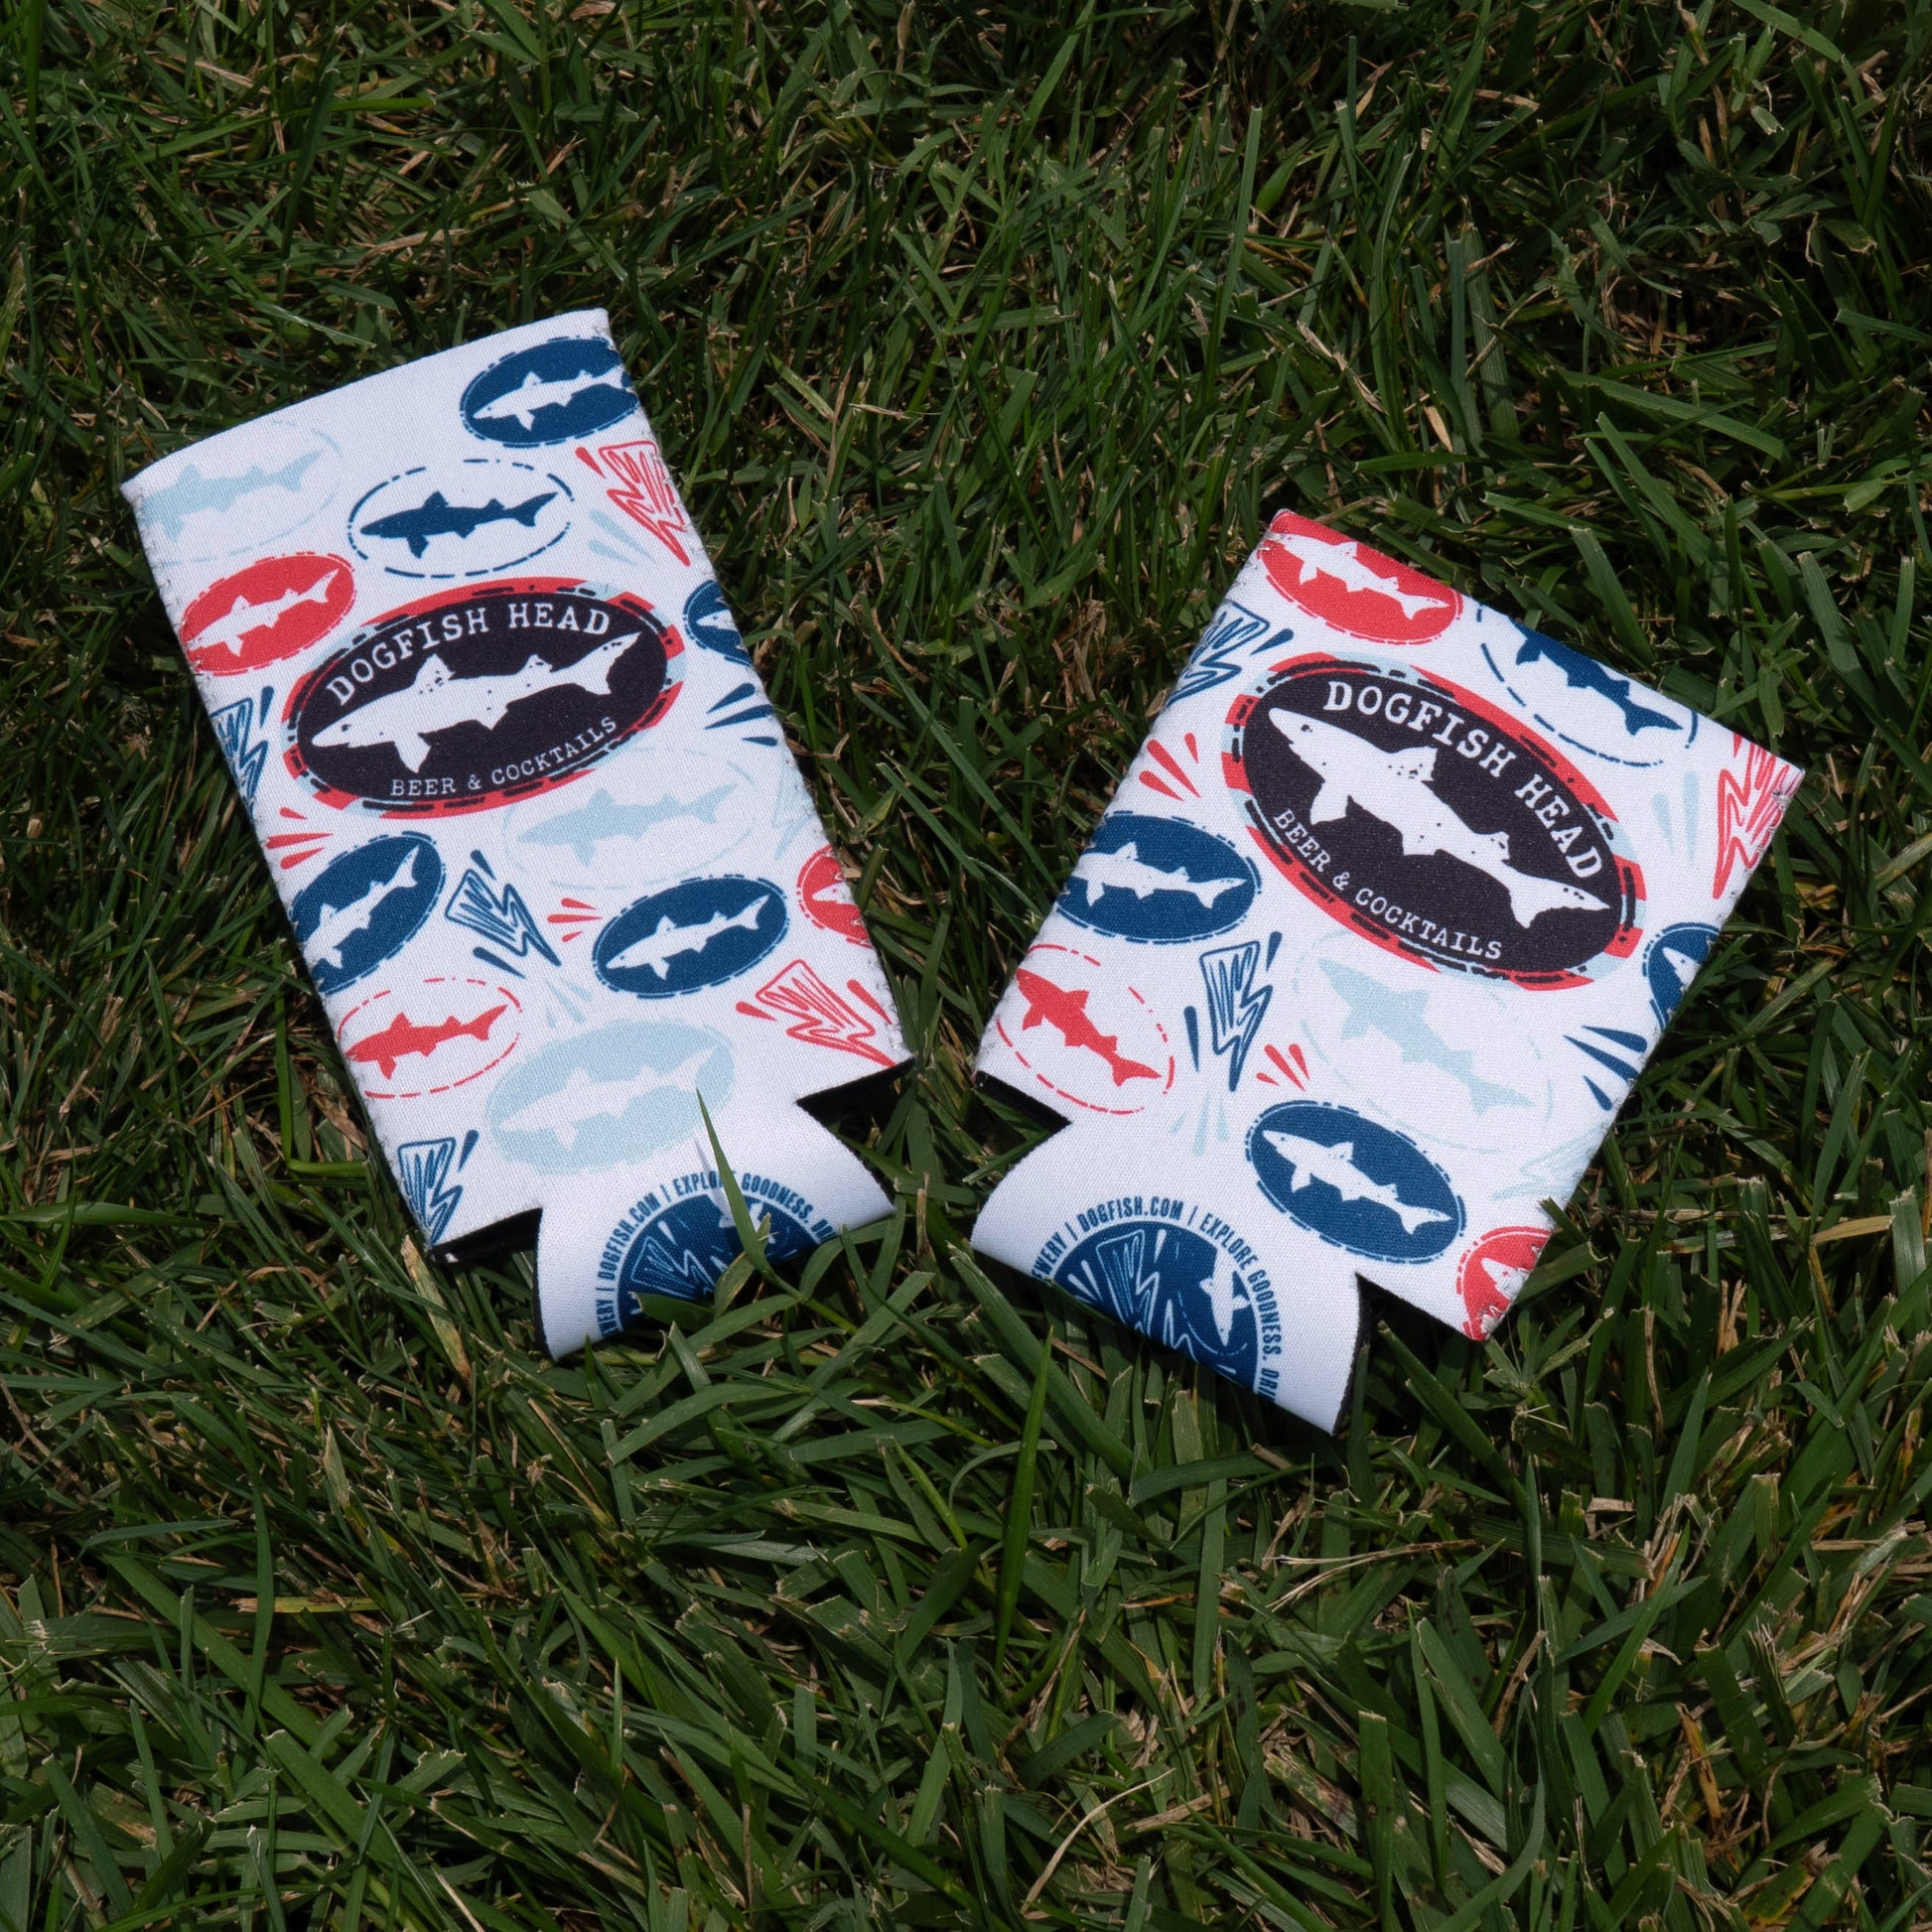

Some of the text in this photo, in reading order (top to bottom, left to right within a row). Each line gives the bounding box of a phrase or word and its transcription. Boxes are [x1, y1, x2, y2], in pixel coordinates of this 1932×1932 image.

[325, 602, 611, 705] DOGFISH HEAD
[389, 716, 618, 797] BEER & COCKTAILS
[1322, 681, 1603, 879] DOGFISH HEAD
[1273, 809, 1503, 961] BEER & COCKTAILS
[598, 1191, 662, 1281] DOGFISH.COM
[672, 1170, 737, 1196] EXPLO
[742, 1173, 814, 1223] GOODNESS.
[1076, 1196, 1184, 1232] DOGFISH.COM
[1199, 1212, 1259, 1271] EXPLORE
[1247, 1269, 1282, 1361] GOODNESS.
